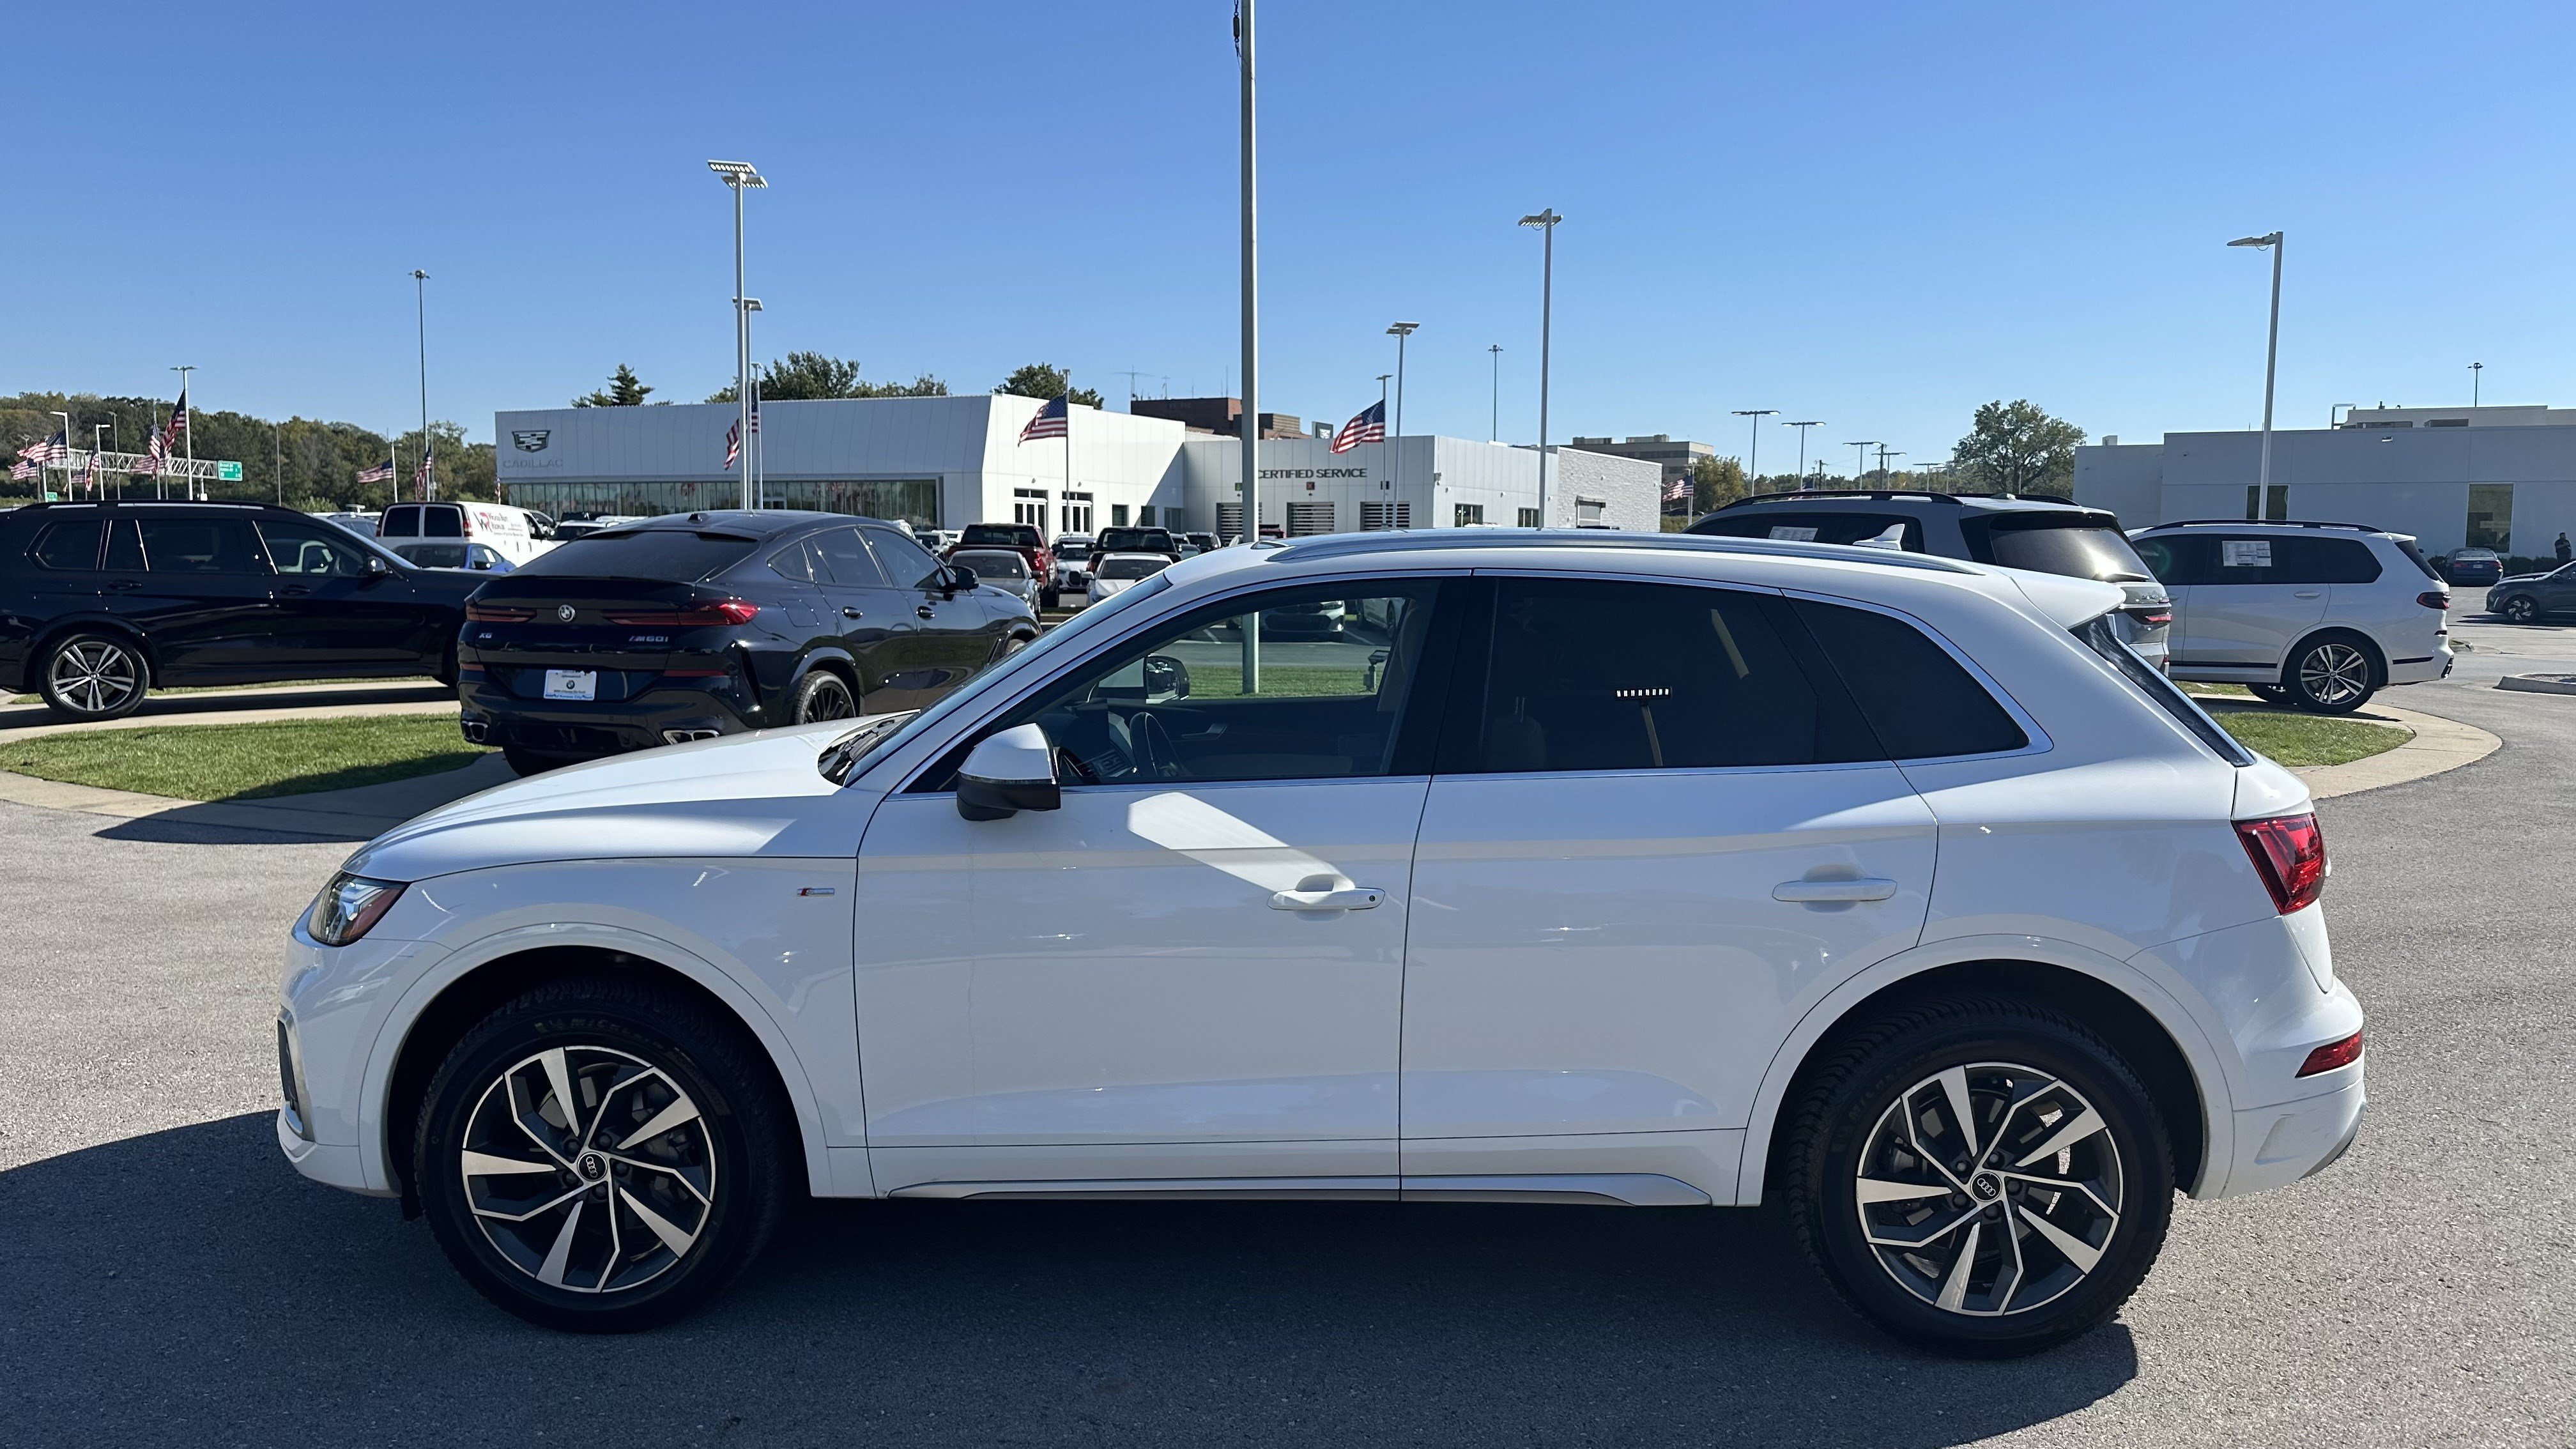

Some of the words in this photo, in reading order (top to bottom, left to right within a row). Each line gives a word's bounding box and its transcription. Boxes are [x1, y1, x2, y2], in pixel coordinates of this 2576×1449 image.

[503, 459, 564, 468] CADILLAC
[1259, 470, 1314, 479] CERTIFIED
[1316, 468, 1367, 479] SERVICE
